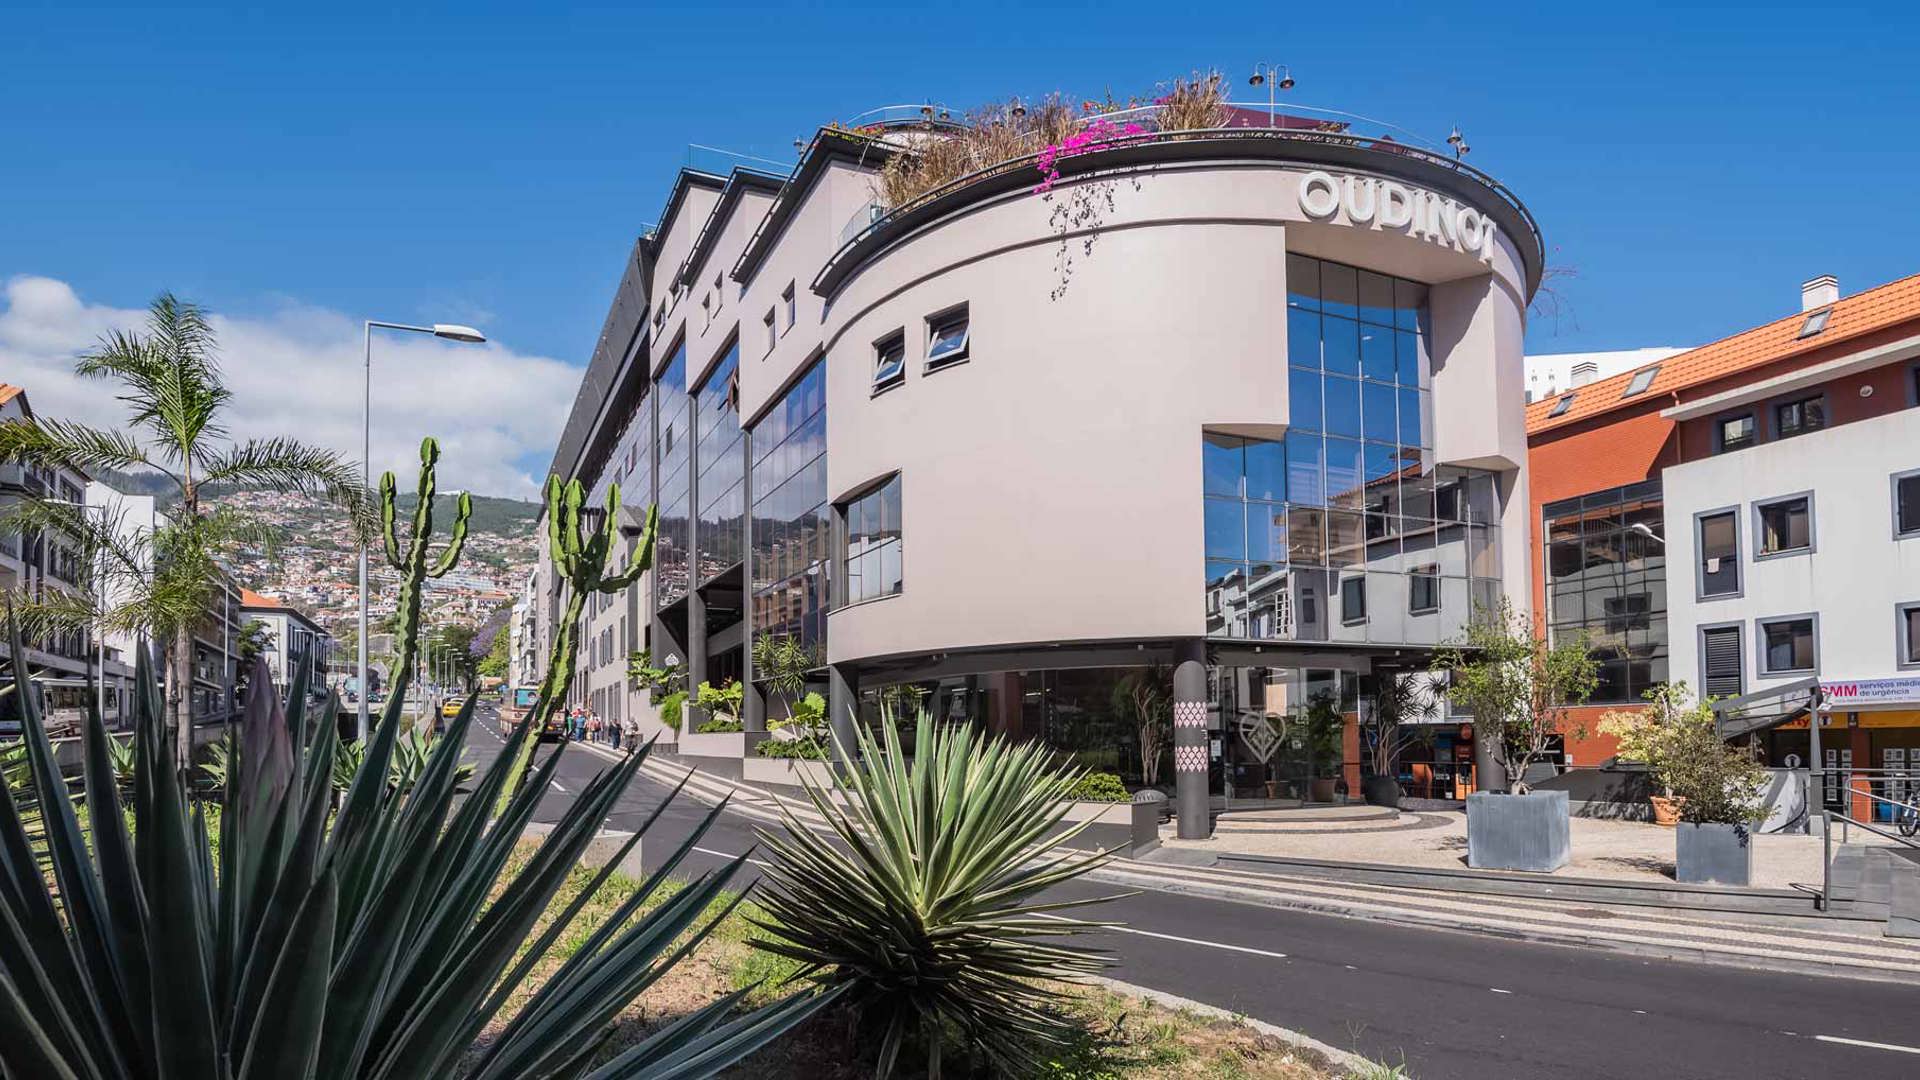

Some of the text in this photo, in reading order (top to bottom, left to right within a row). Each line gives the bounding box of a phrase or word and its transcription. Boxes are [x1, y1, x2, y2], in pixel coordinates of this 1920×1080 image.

[1298, 171, 1497, 263] OUDINOT
[1859, 681, 1895, 690] serviços
[1872, 688, 1910, 697] urgência
